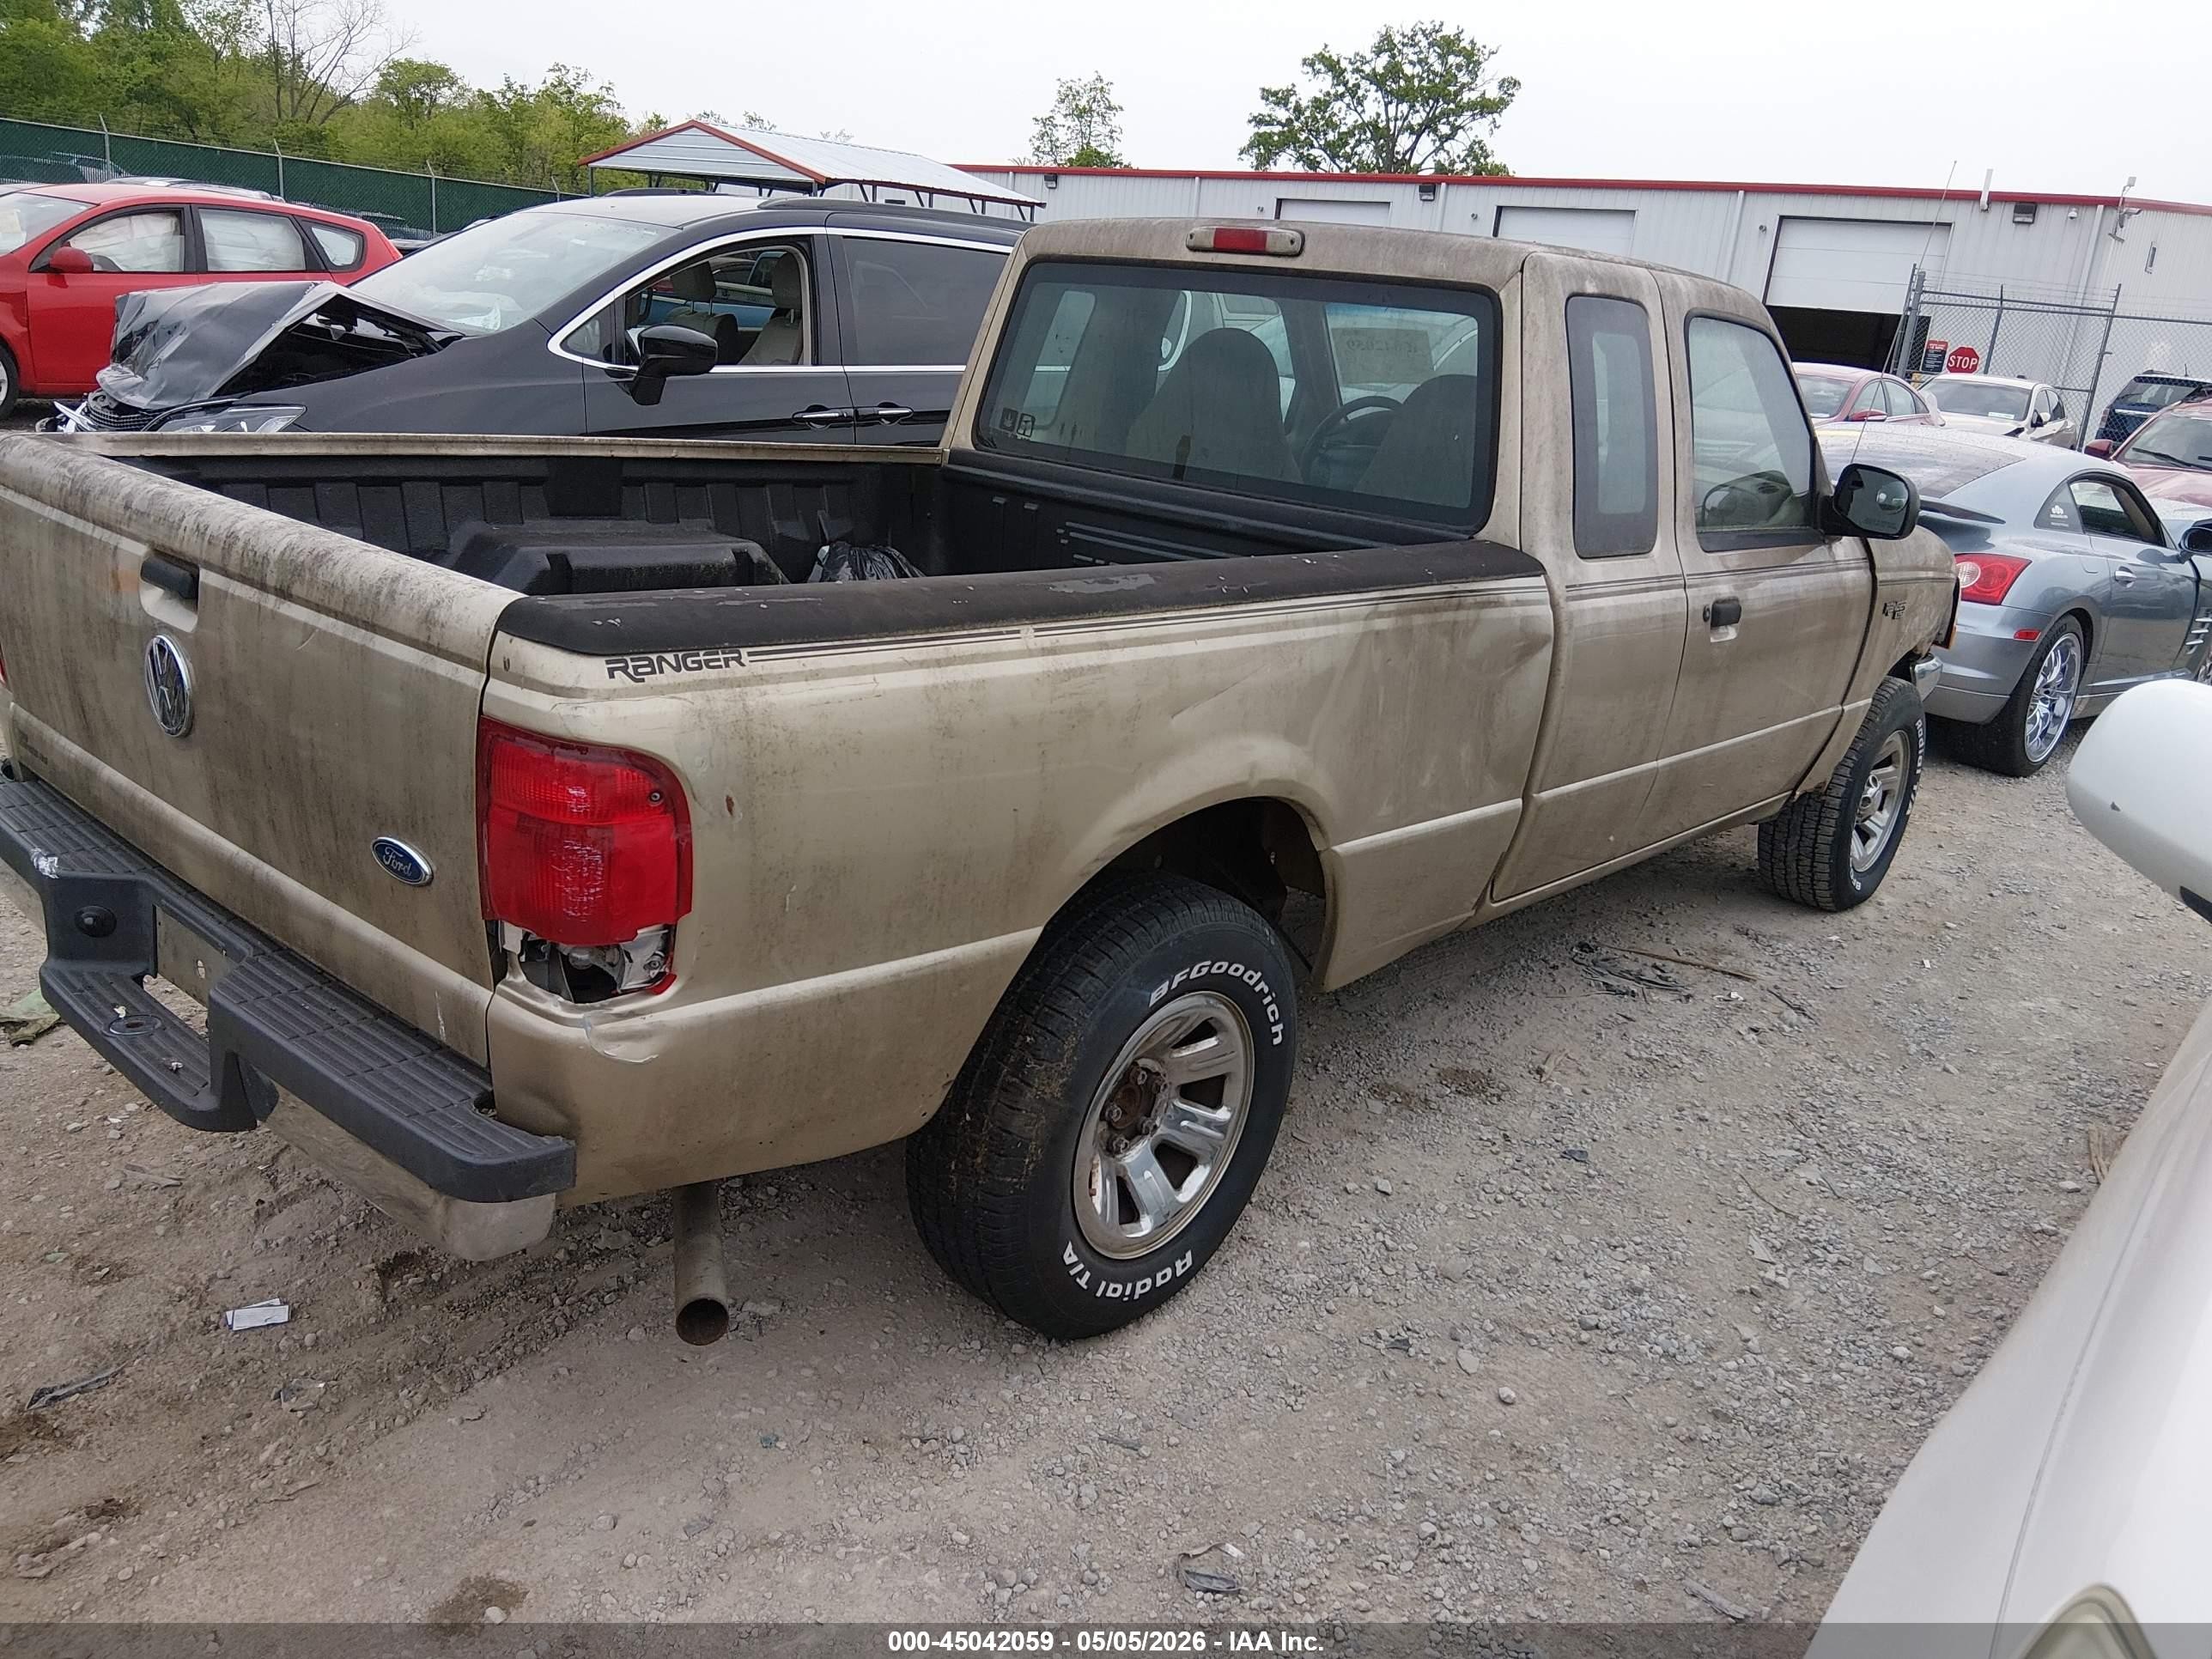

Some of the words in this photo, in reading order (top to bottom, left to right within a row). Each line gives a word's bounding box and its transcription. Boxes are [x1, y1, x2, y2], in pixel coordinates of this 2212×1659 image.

[1948, 355, 1978, 369] STOP
[605, 648, 746, 683] RANGER
[383, 847, 412, 876] Ford
[1150, 960, 1285, 1045] BFGoodrich
[1061, 1241, 1090, 1290] T/A
[1096, 1249, 1194, 1301] Radial
